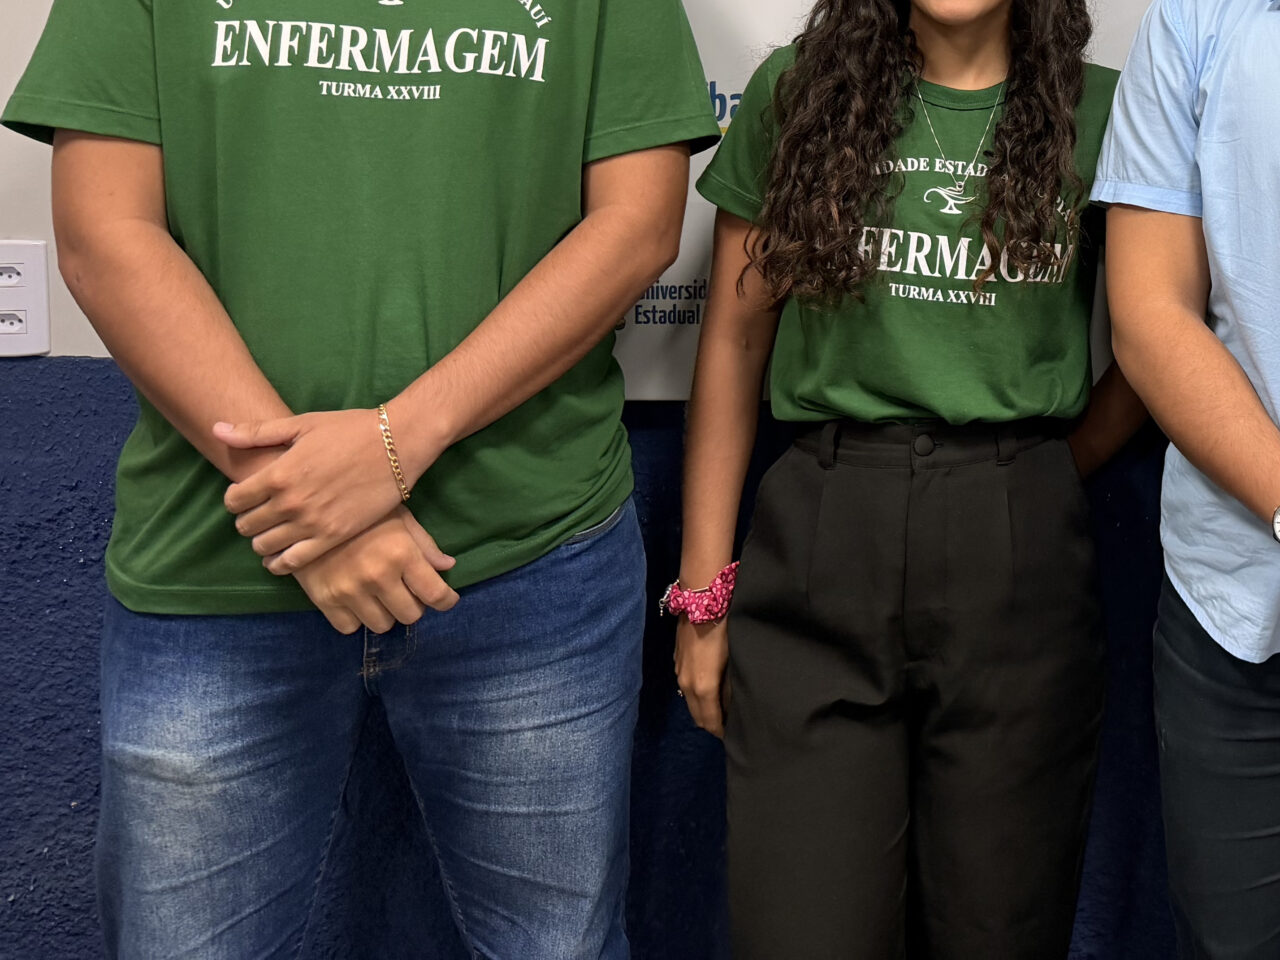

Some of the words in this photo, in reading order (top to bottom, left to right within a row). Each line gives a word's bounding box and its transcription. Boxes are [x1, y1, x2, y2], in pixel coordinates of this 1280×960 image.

[211, 19, 550, 83] ENFERMAGEM
[319, 80, 382, 99] TURMA
[386, 84, 441, 100] XXVIII
[934, 157, 989, 178] ESTAD
[643, 279, 708, 300] niversid
[888, 283, 945, 302] TURMA
[946, 290, 997, 307] XXVIII
[634, 303, 701, 325] Estadual
